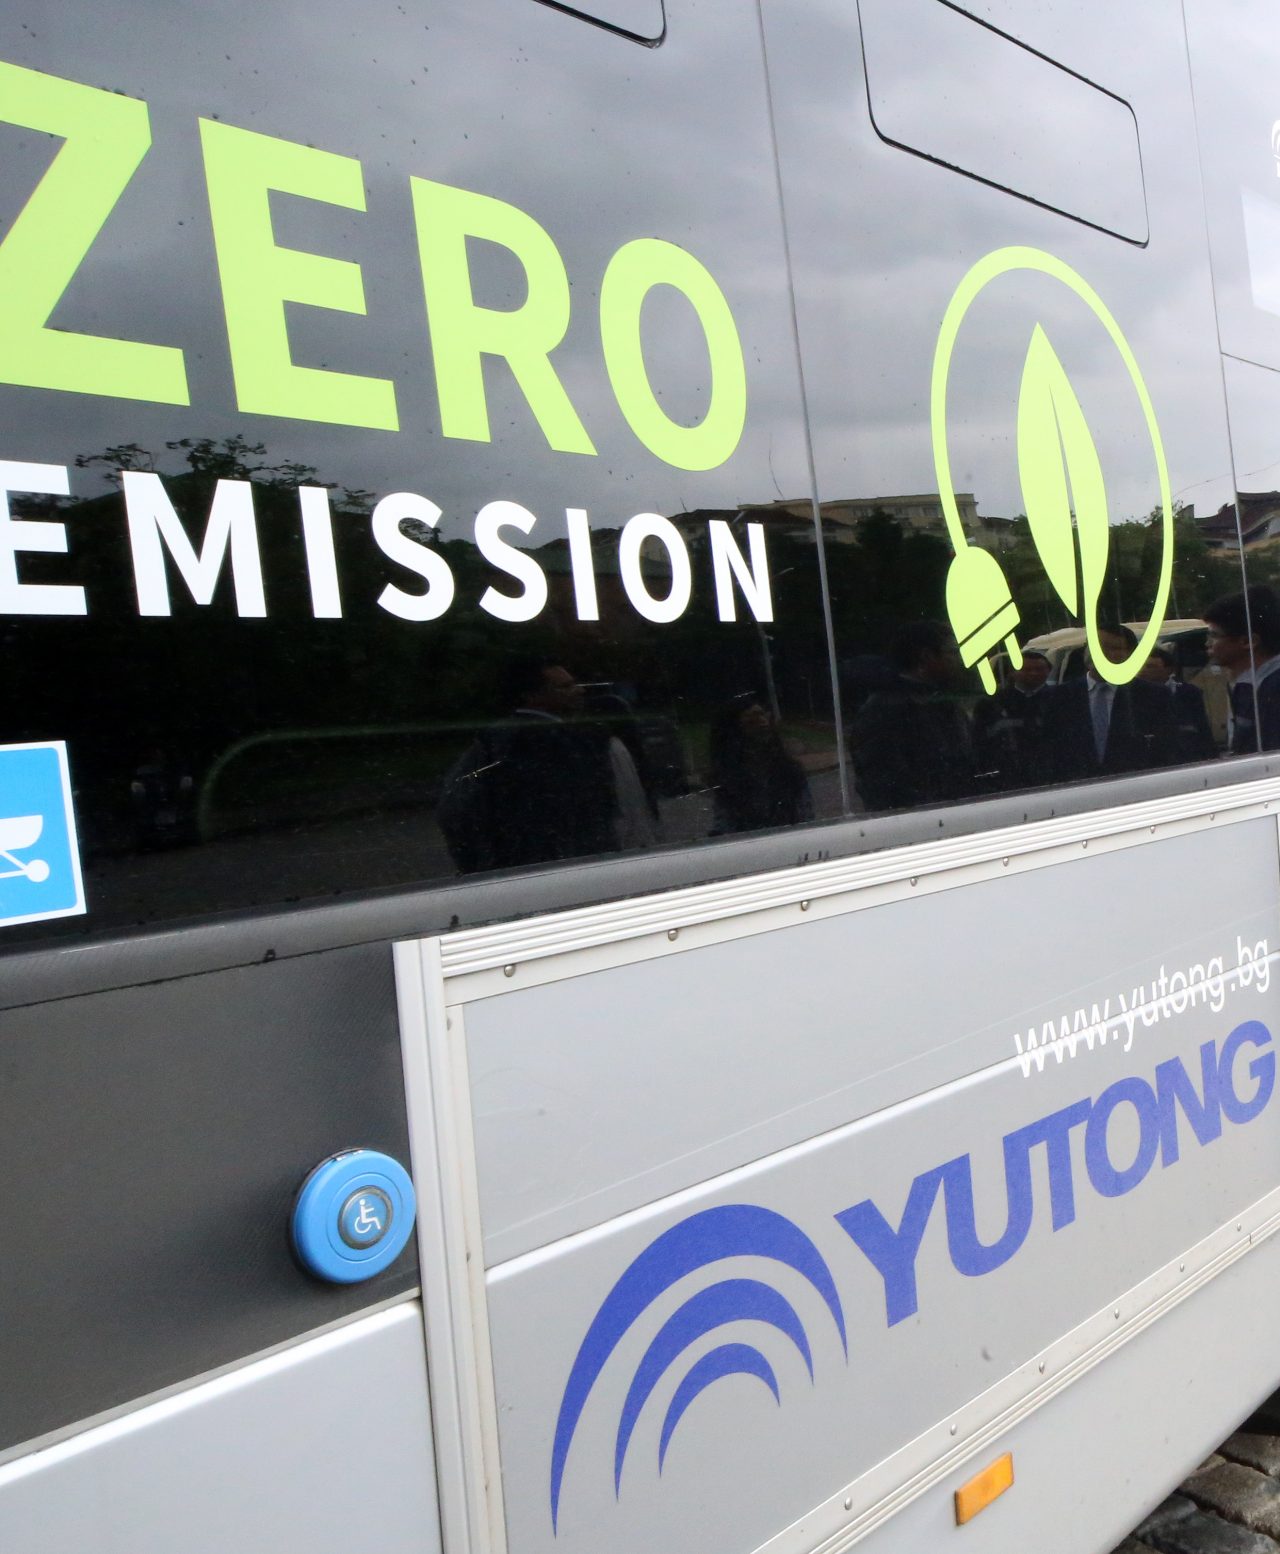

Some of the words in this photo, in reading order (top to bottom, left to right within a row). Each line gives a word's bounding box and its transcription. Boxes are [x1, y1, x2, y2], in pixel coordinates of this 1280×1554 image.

[0, 61, 748, 472] ZERO
[0, 459, 775, 625] EMISSION
[1014, 936, 1271, 1079] www.yutong.bg
[834, 1020, 1277, 1329] YUTONG
